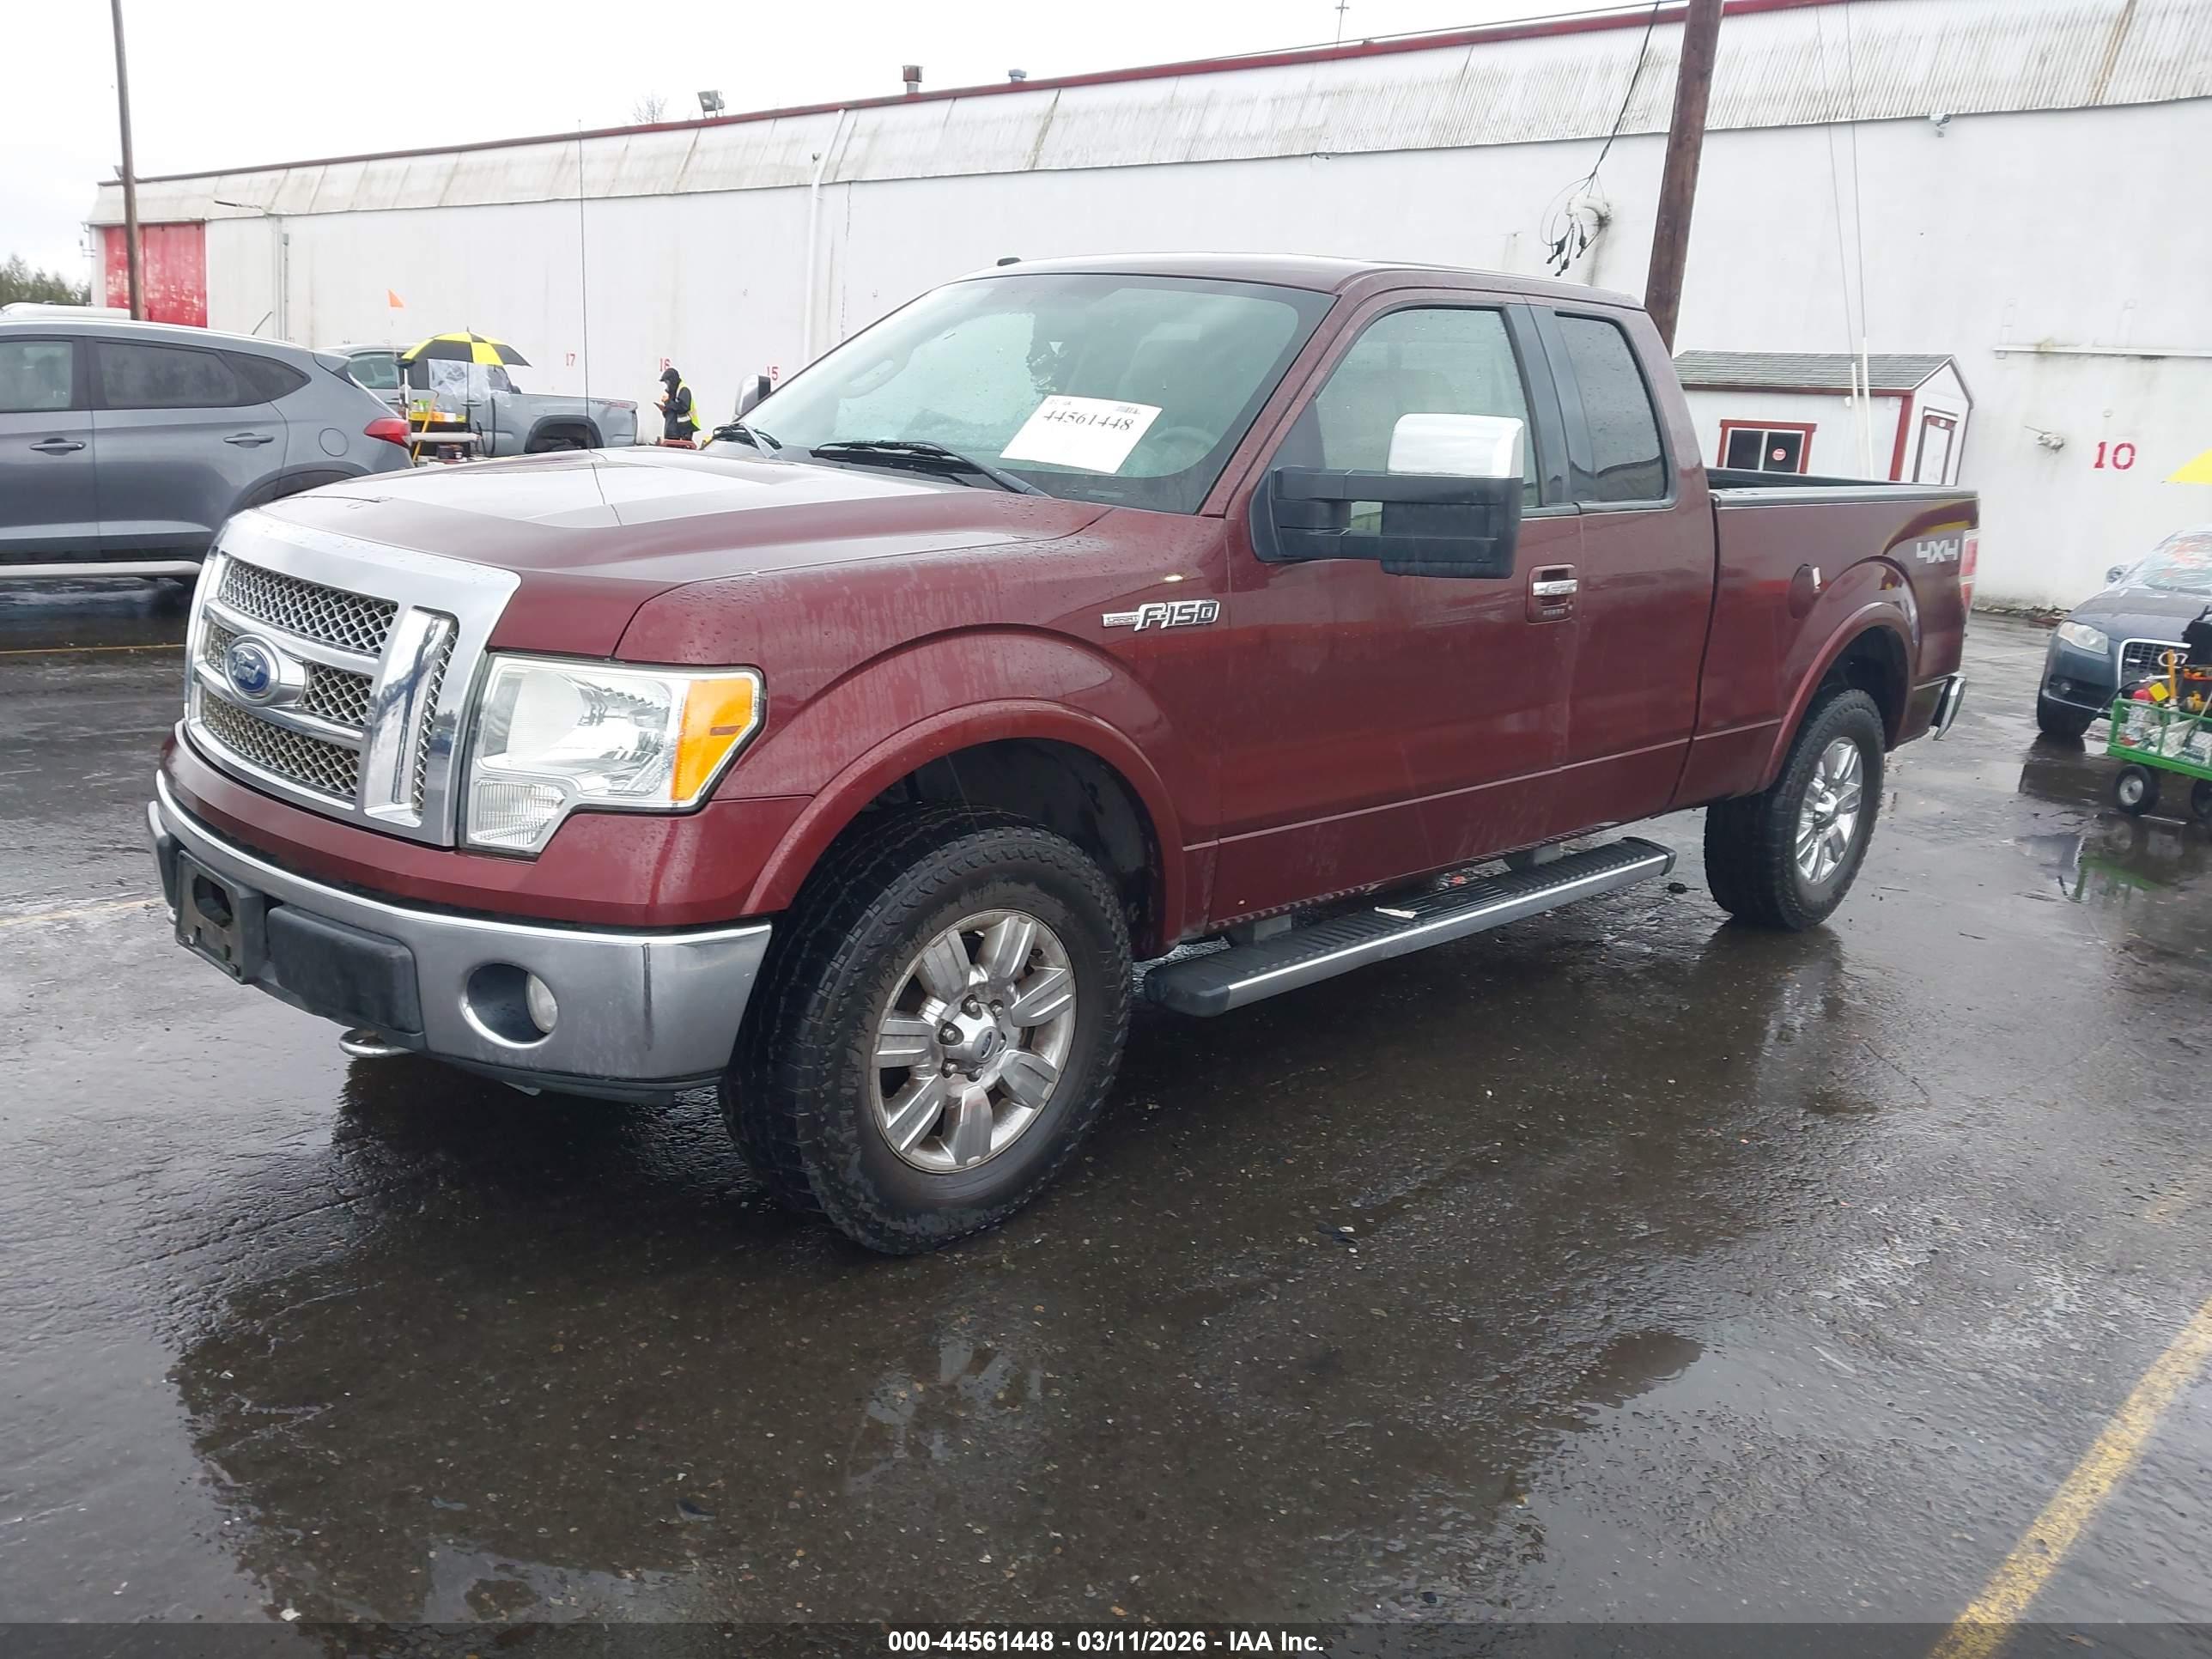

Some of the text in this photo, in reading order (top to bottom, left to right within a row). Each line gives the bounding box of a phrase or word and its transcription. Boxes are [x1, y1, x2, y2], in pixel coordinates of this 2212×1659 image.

[566, 353, 576, 367] 17
[767, 366, 779, 381] 15
[1043, 410, 1134, 431] 44561448
[2094, 441, 2136, 471] 10
[232, 650, 261, 684] Ford
